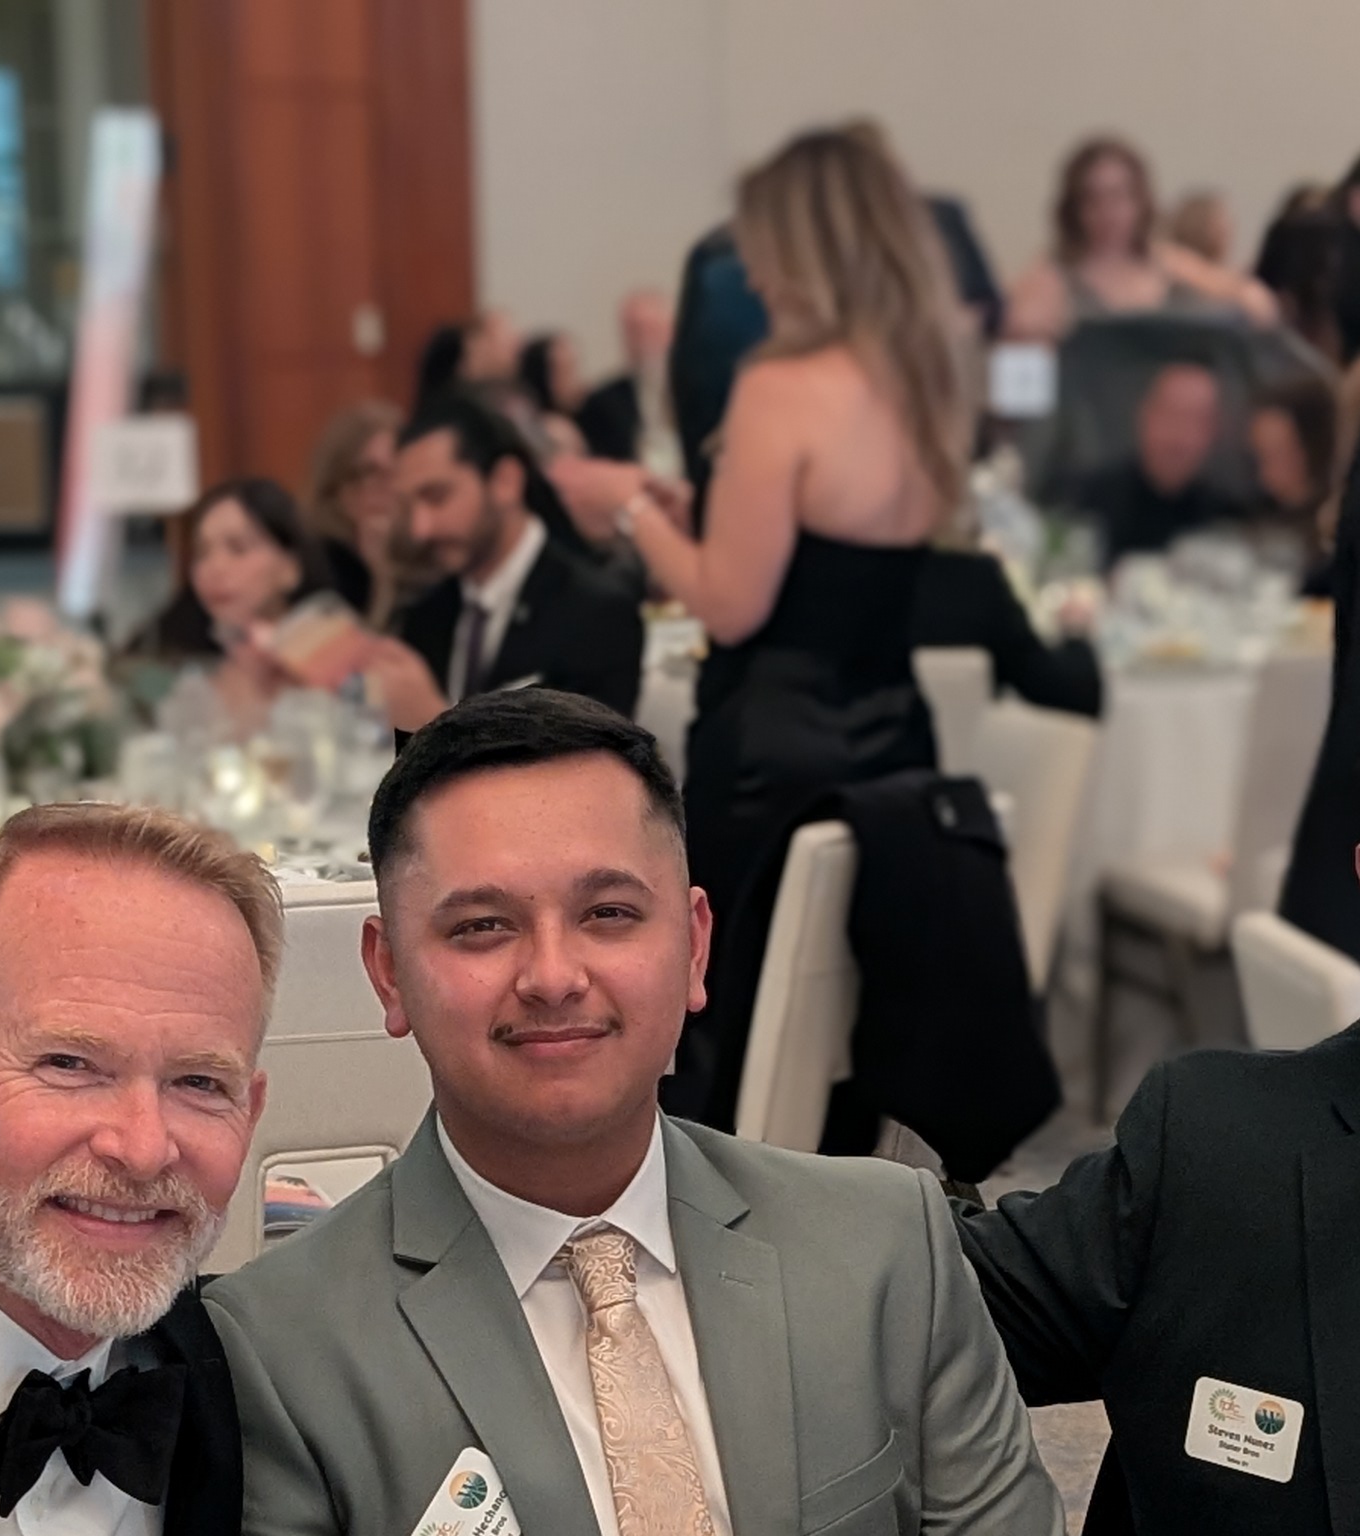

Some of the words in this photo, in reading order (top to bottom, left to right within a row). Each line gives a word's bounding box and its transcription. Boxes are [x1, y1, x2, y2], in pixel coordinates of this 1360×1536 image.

[1208, 1424, 1240, 1441] Steven
[1244, 1435, 1275, 1451] Nunez
[491, 1517, 508, 1535] Bros
